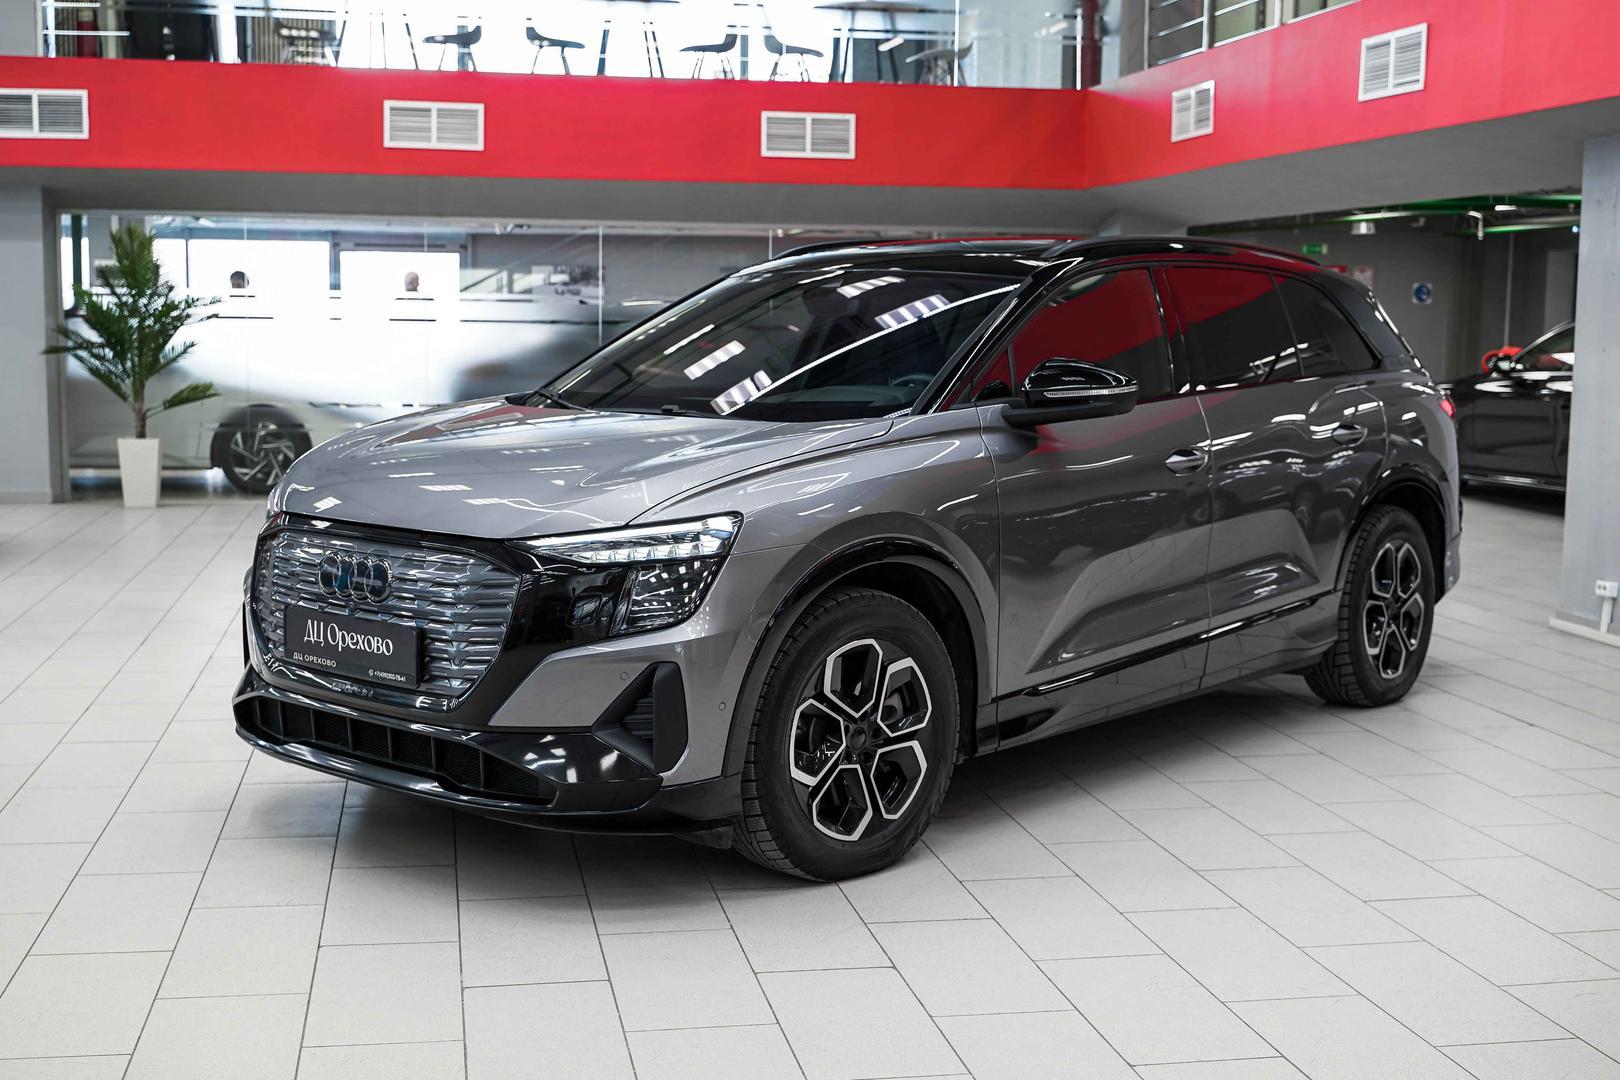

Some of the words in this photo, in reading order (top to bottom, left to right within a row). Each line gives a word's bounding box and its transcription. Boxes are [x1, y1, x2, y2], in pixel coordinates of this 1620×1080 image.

[304, 619, 325, 647] ДЦ
[327, 623, 394, 656] Орехово
[293, 652, 303, 661] ДЦ
[304, 654, 337, 667] ОРЕХОВО
